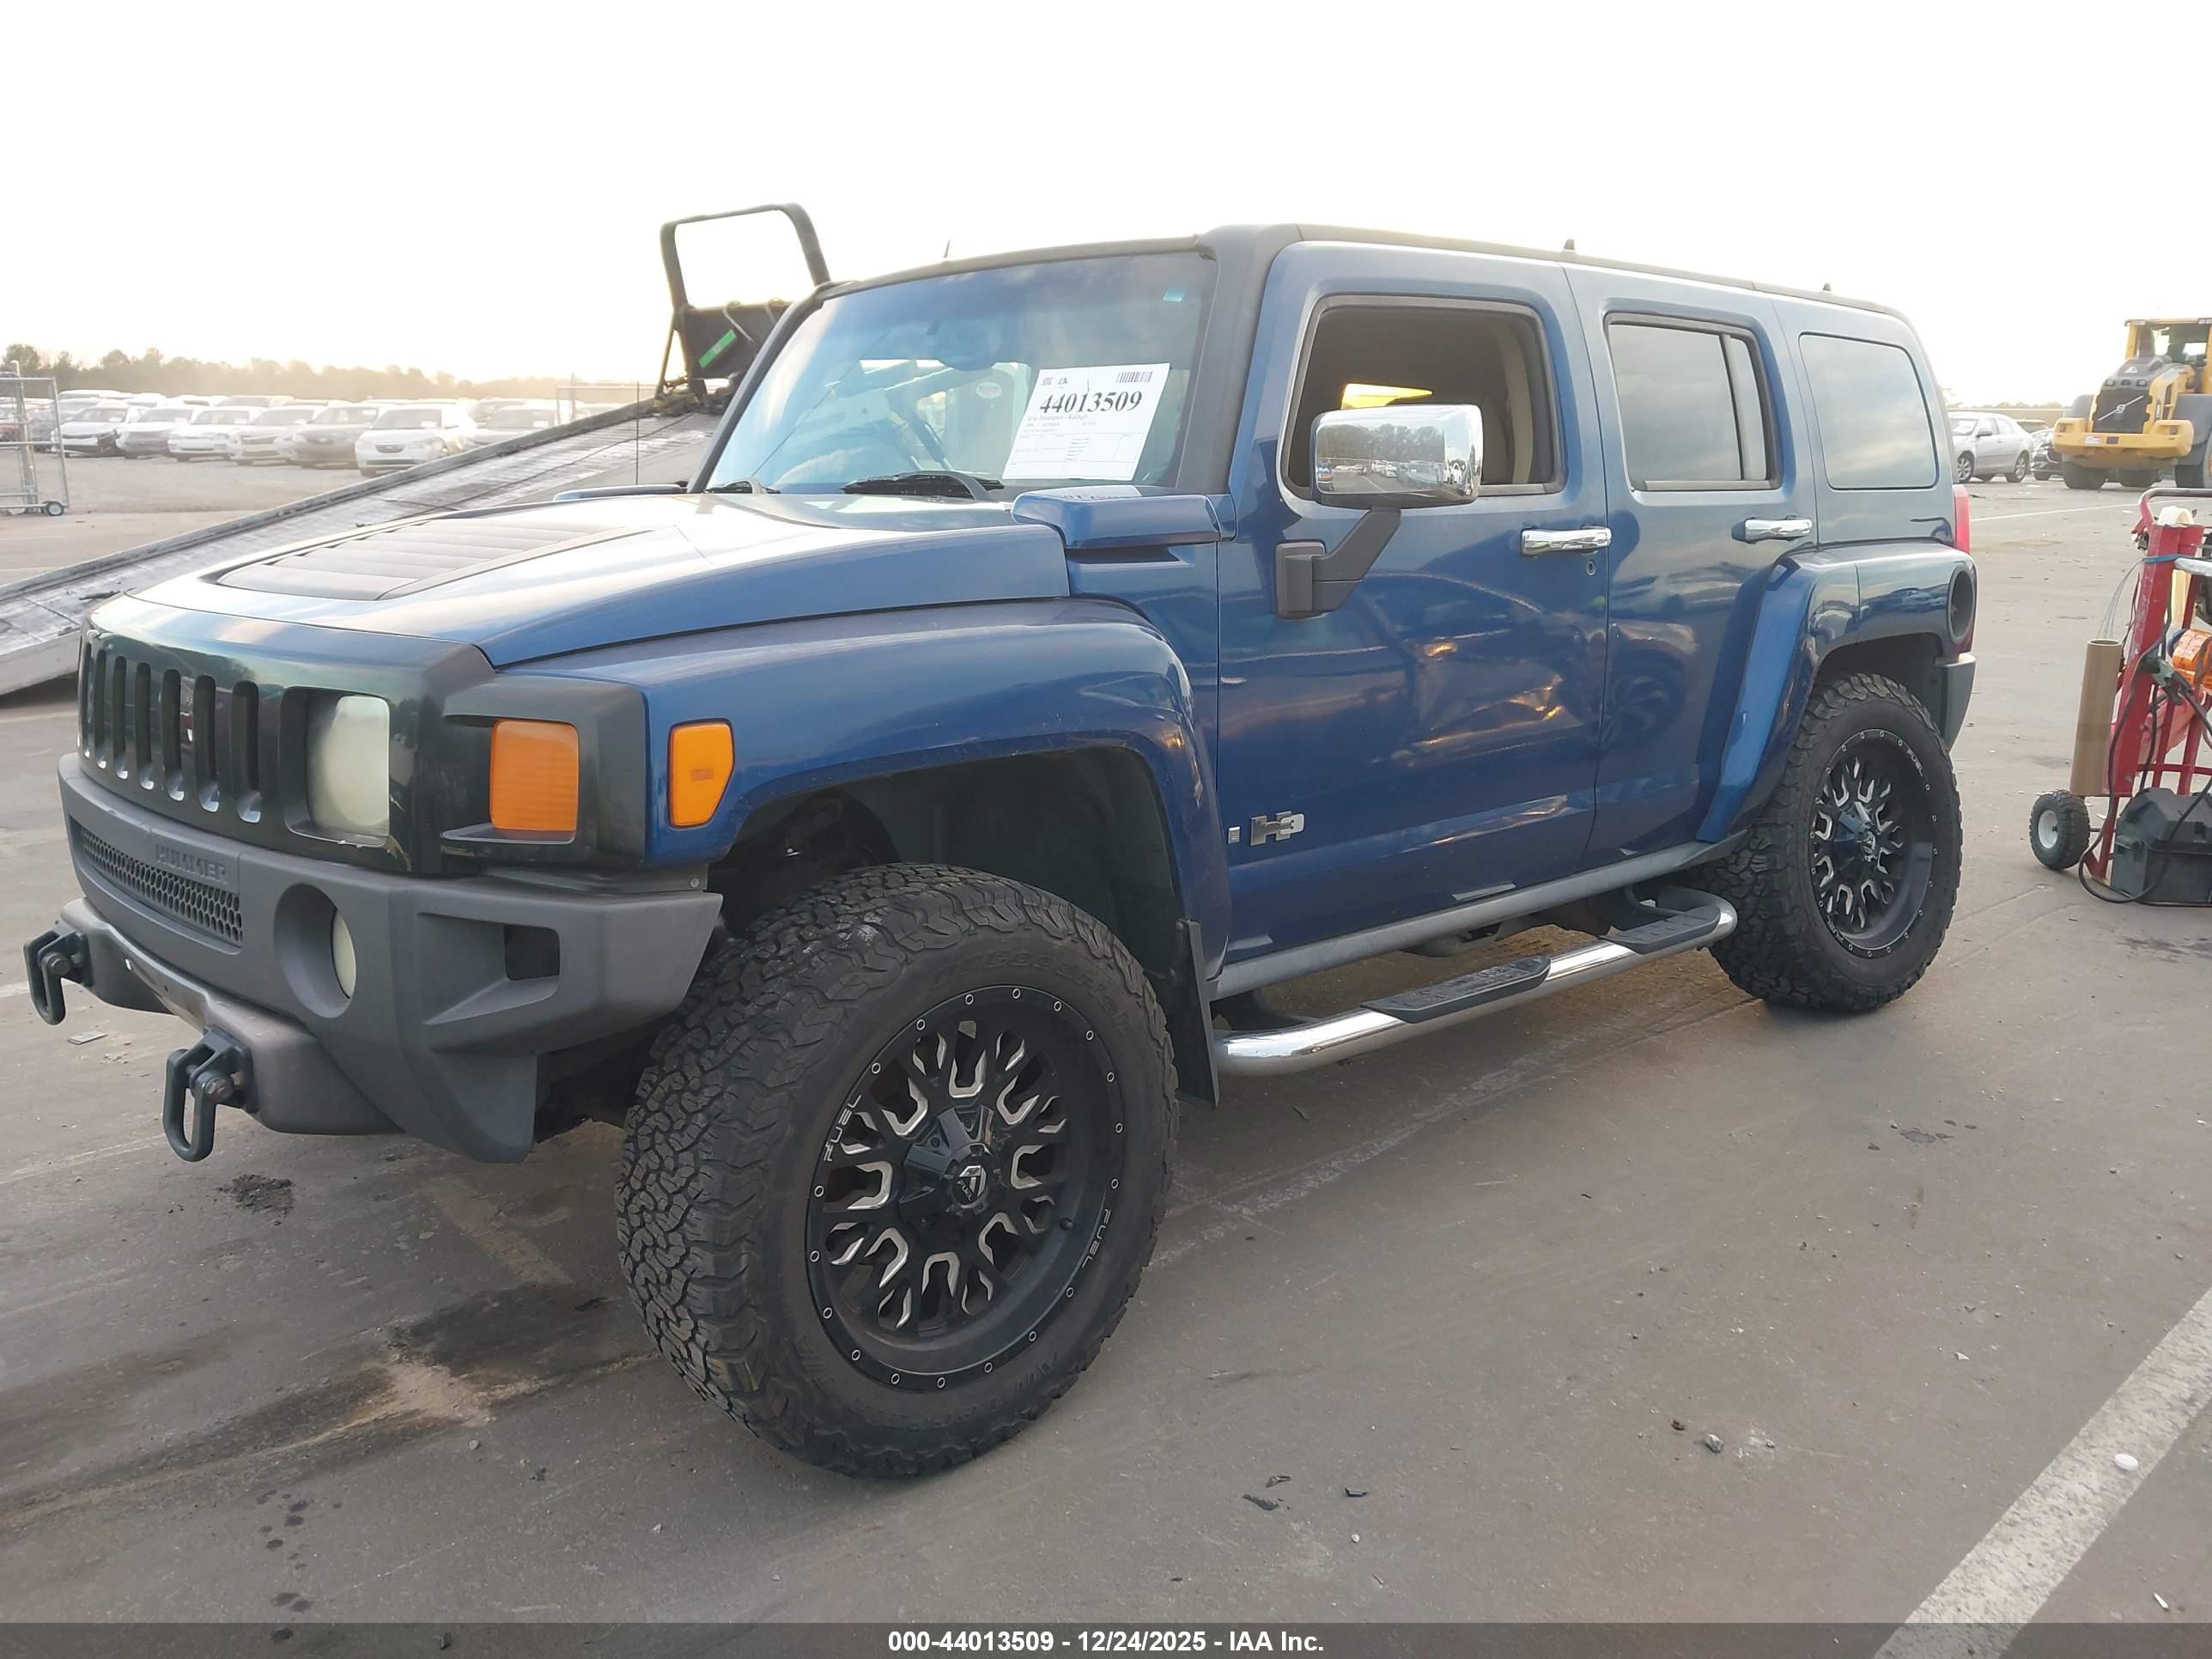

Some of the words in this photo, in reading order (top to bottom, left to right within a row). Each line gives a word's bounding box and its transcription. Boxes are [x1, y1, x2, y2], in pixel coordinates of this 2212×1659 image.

[1039, 391, 1142, 414] 44013509
[1250, 811, 1305, 846] H3
[155, 844, 228, 884] HUMMER
[823, 1093, 862, 1162] FUEL
[957, 1179, 973, 1202] FUEL
[1081, 1208, 1112, 1269] FUEL
